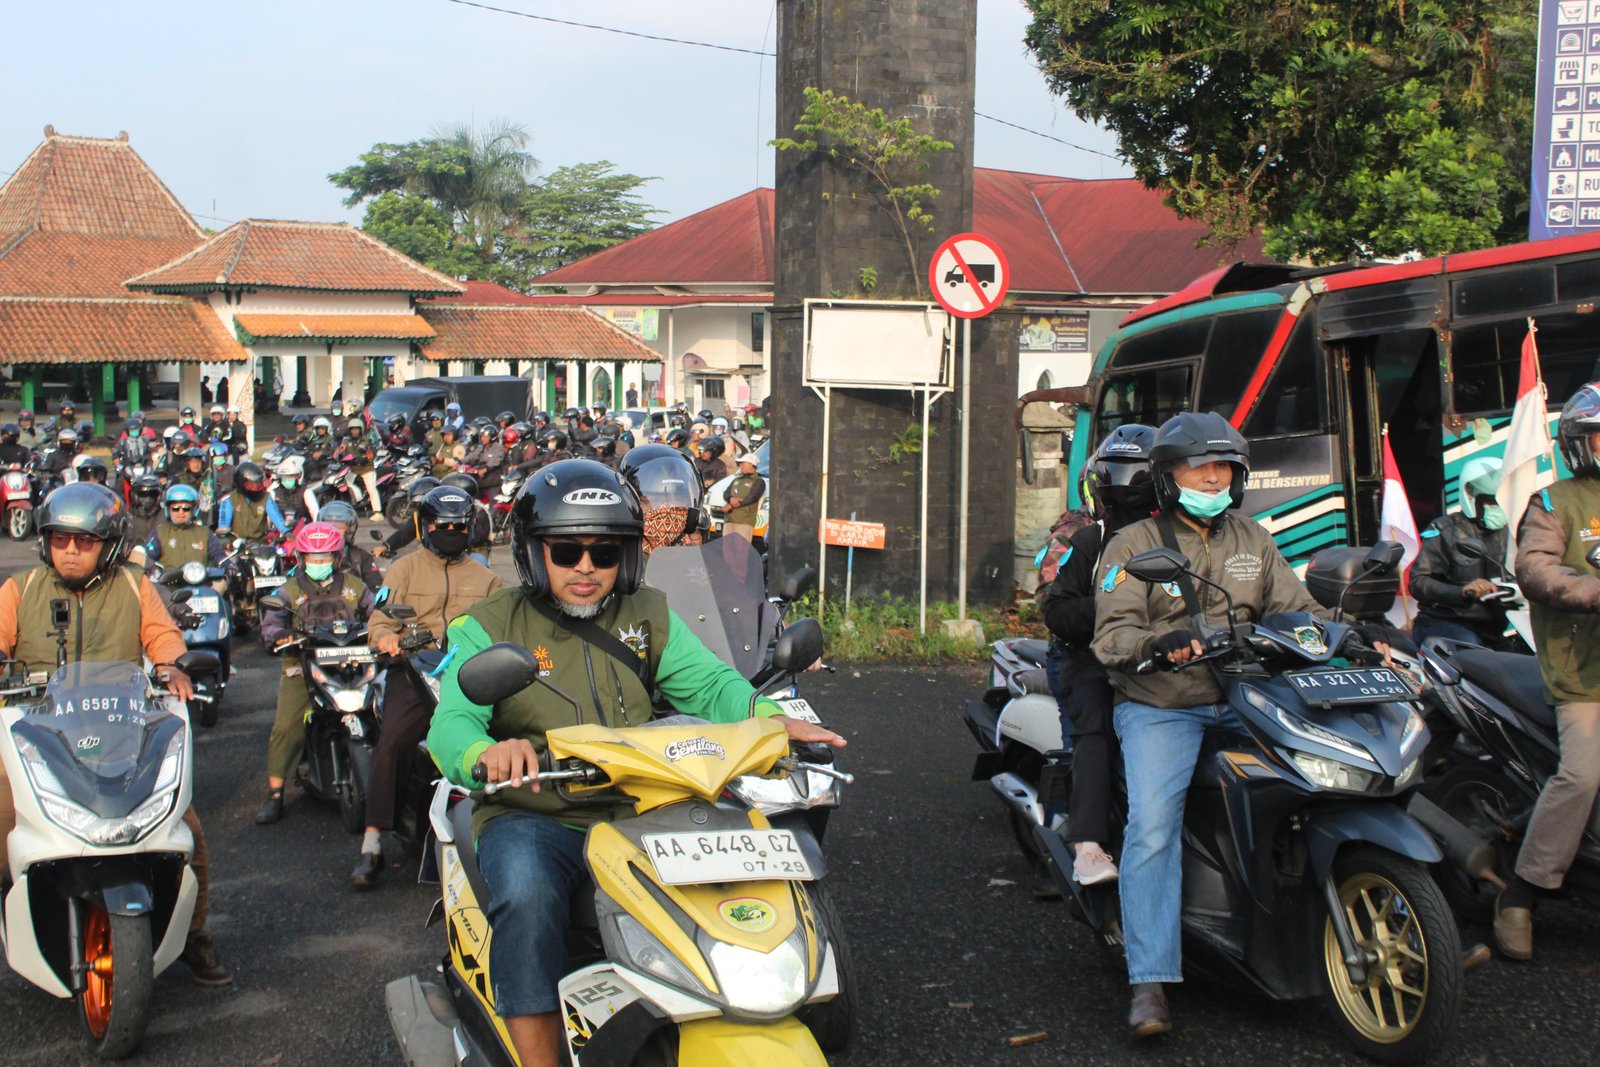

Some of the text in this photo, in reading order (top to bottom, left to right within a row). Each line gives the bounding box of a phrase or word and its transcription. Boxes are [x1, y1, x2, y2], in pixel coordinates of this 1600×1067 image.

[1262, 475, 1330, 489] BERSENYUM
[571, 491, 613, 501] INK
[1296, 676, 1321, 688] AA
[1325, 673, 1367, 686] 3211
[55, 698, 147, 716] AA 6587 NZ
[789, 701, 807, 712] HP
[664, 737, 725, 761] Gemilang
[653, 839, 686, 858] AA
[697, 835, 756, 855] 6448
[568, 981, 624, 1006] 125
